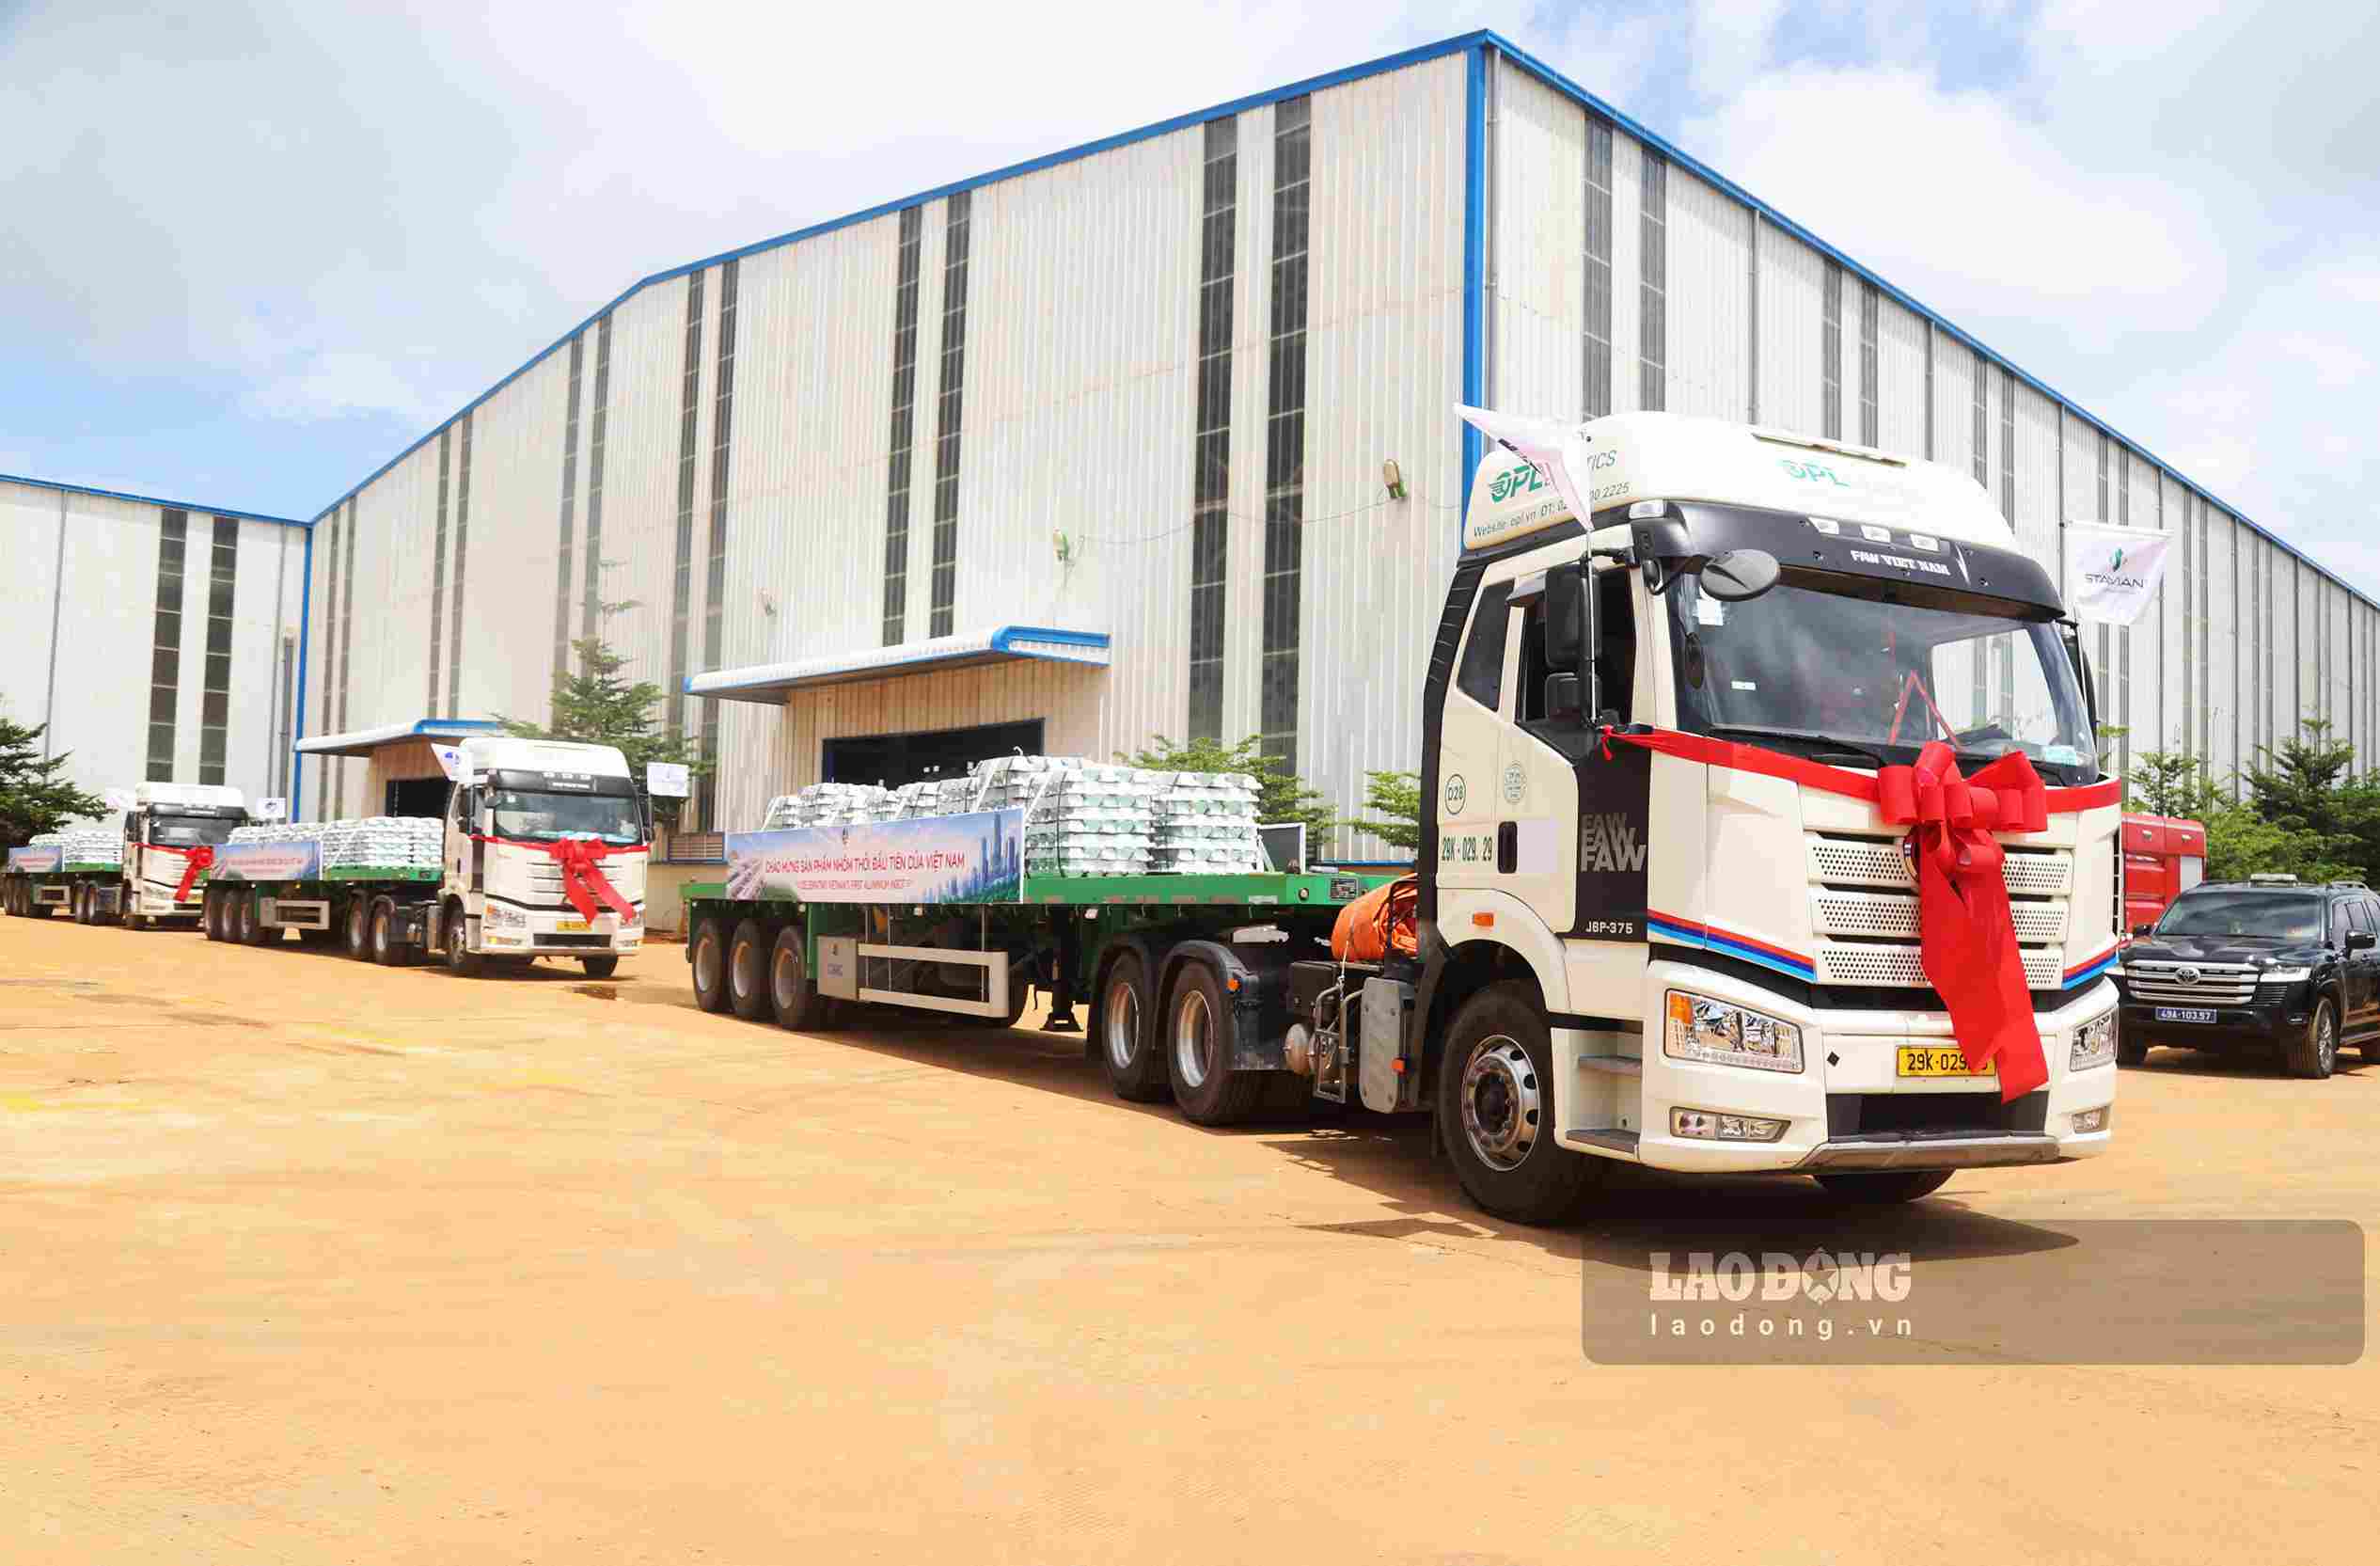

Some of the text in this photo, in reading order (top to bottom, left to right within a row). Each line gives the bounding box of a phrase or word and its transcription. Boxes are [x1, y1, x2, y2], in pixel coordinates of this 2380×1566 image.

[1850, 549, 1951, 576] FAW VIET NAM
[2084, 573, 2144, 588] STAVIAN
[945, 852, 965, 868] NAM
[1580, 844, 1647, 872] FAW
[1585, 921, 1633, 934] J6P-375
